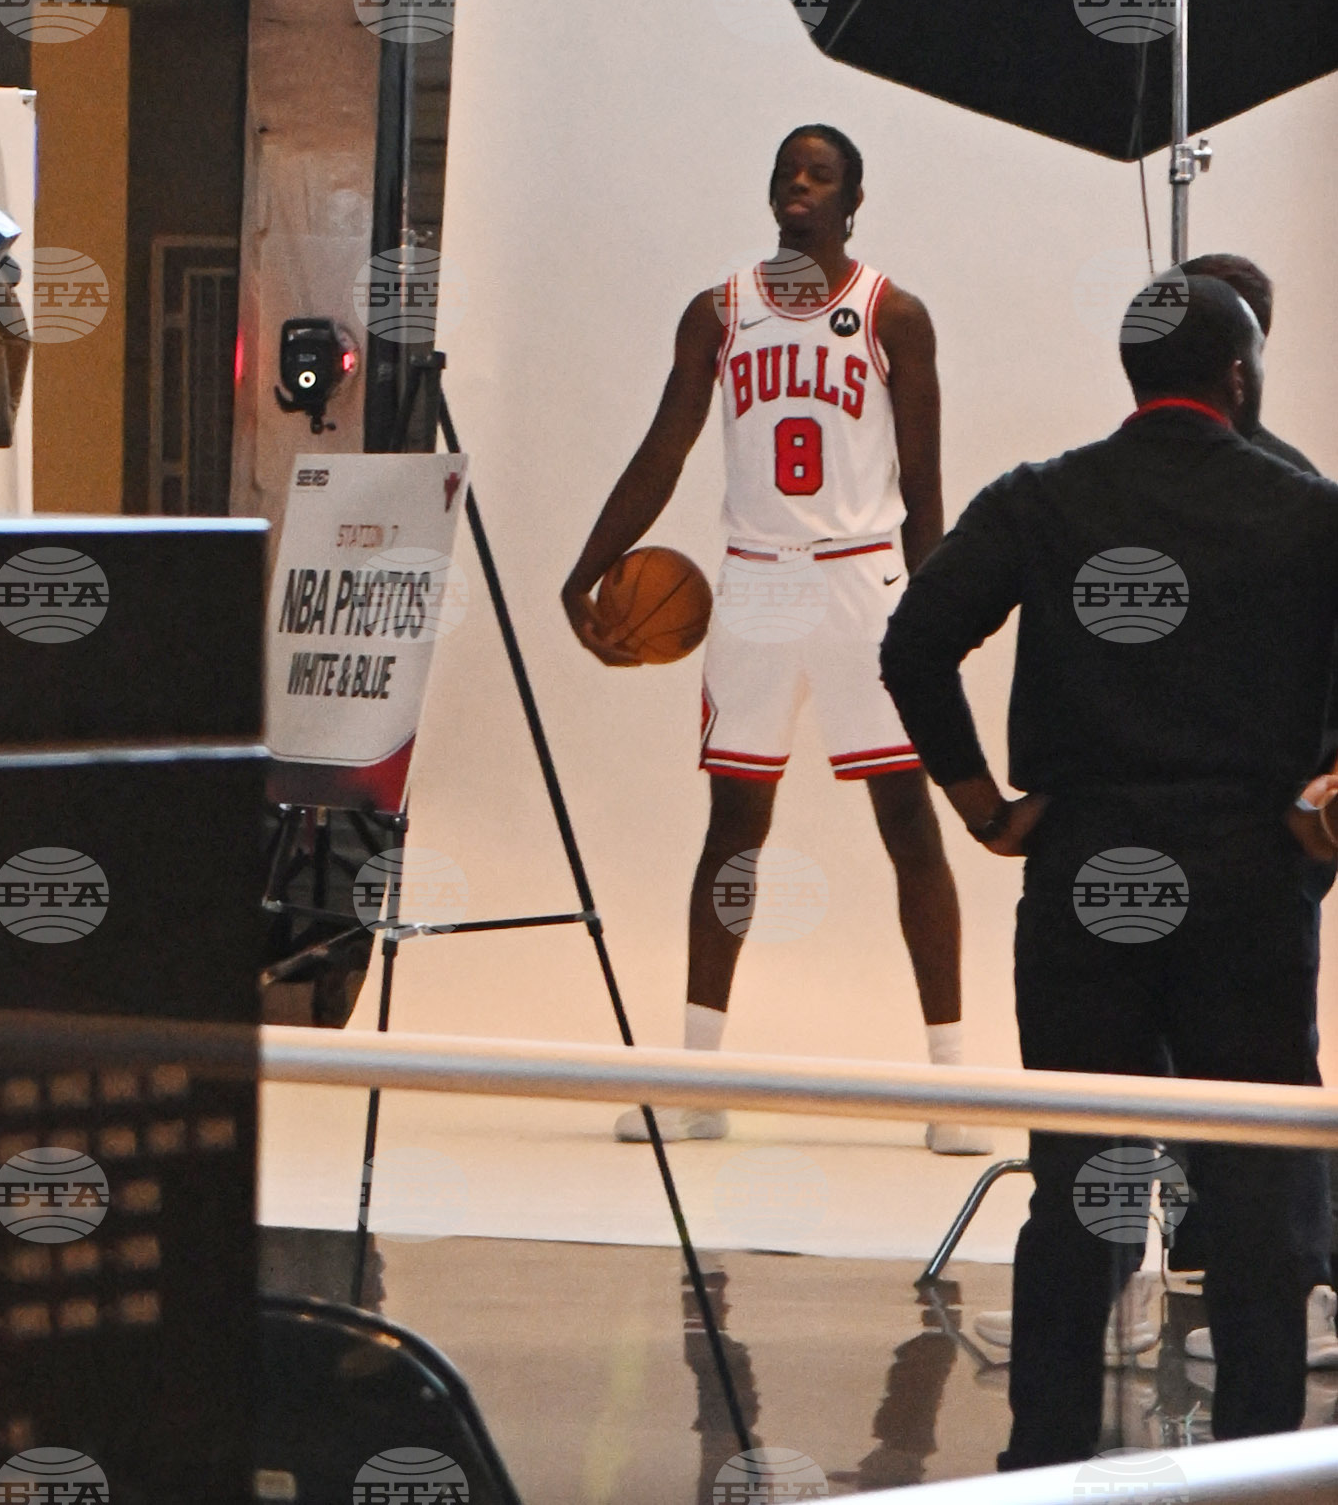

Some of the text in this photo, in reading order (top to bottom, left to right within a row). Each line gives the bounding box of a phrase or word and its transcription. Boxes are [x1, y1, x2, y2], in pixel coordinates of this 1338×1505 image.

[730, 343, 868, 420] BULLS
[774, 417, 823, 496] 8
[278, 569, 431, 638] NBA PHOTOS
[287, 652, 397, 700] WHITE & BLUE
